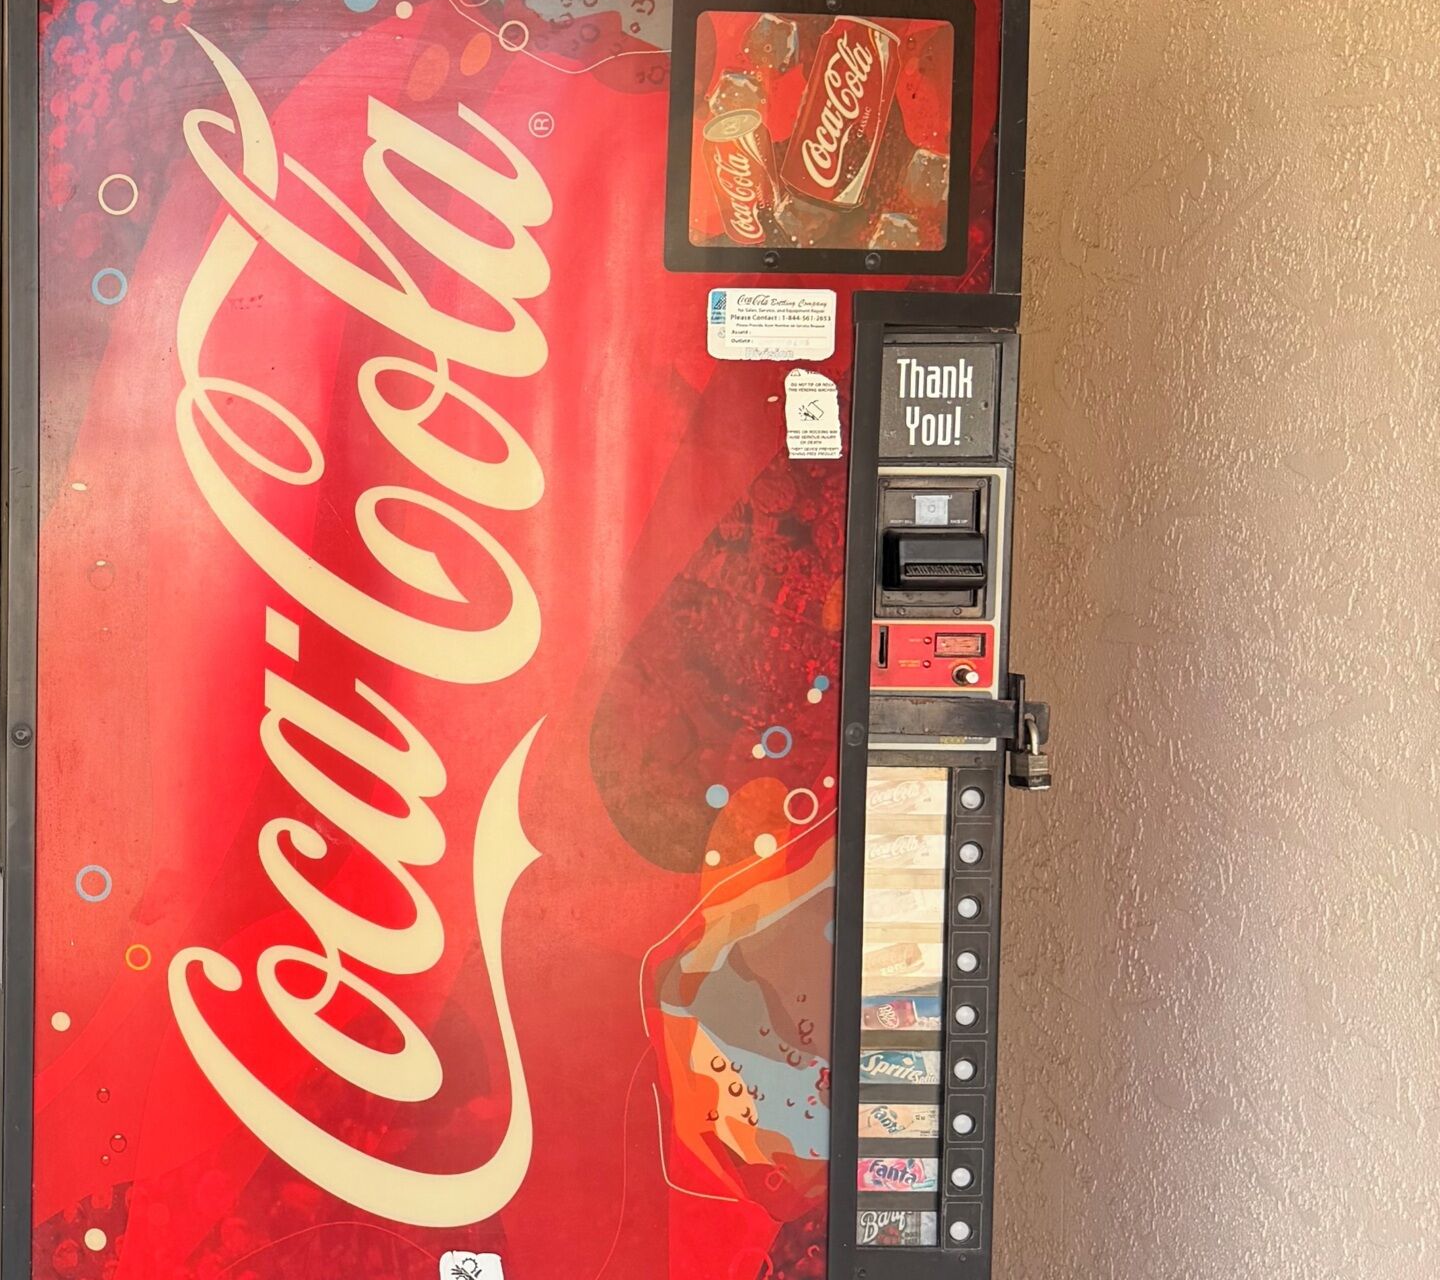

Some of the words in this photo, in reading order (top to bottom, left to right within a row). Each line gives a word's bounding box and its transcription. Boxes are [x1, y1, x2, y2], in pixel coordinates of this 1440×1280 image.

[802, 30, 874, 188] Coca-Cola
[713, 144, 764, 238] Coca-Cola
[896, 358, 974, 398] Thank
[905, 405, 962, 446] You!
[167, 23, 554, 1228] Coca-Cola
[860, 1054, 923, 1081] Sprite
[869, 1160, 917, 1184] Fanta
